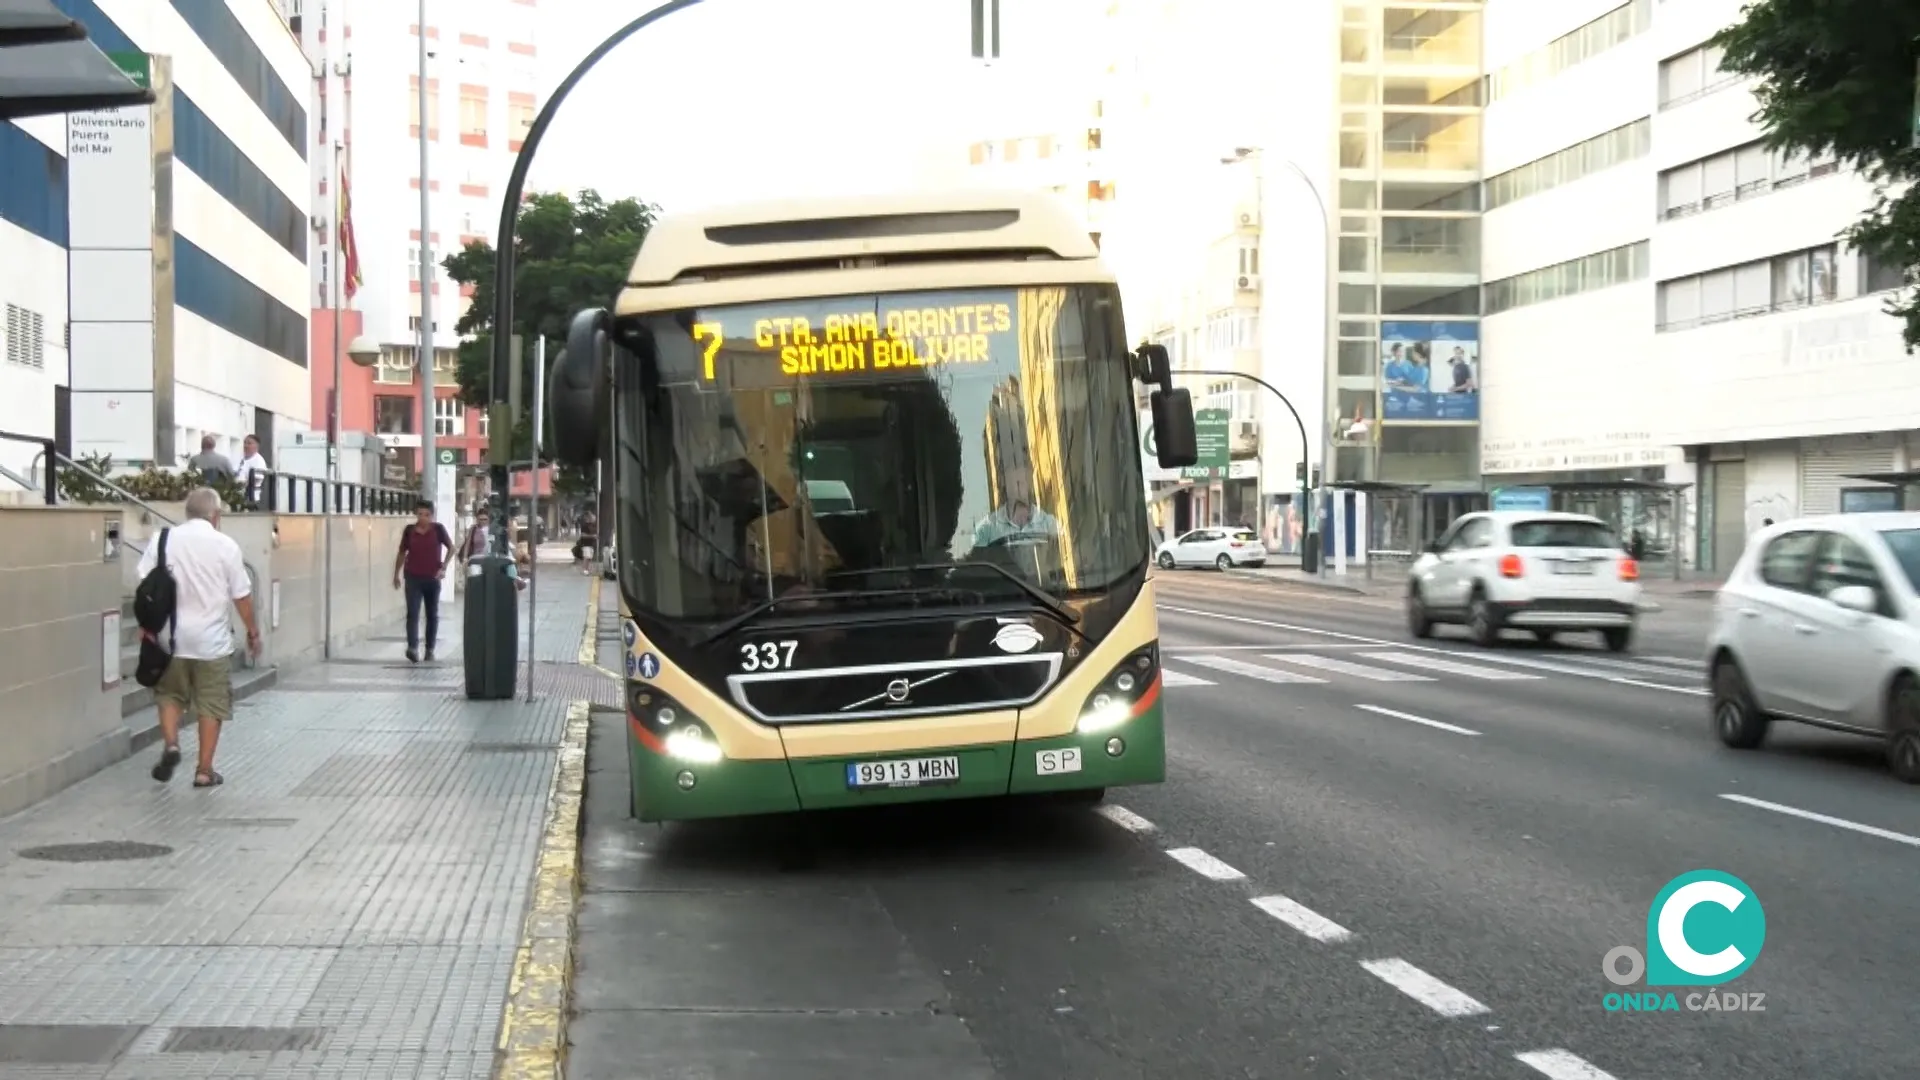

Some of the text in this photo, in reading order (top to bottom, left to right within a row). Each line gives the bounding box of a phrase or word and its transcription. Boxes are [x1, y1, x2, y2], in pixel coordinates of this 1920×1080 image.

[72, 116, 146, 129] Universitario
[72, 130, 110, 141] Puerta
[72, 144, 113, 154] del Mar
[755, 304, 1010, 349] GTA. ANA ORANTES
[694, 322, 723, 380] 7
[781, 334, 990, 374] SIMON BOLIVAR
[740, 639, 799, 672] 337
[861, 758, 956, 782] 9913 MBN
